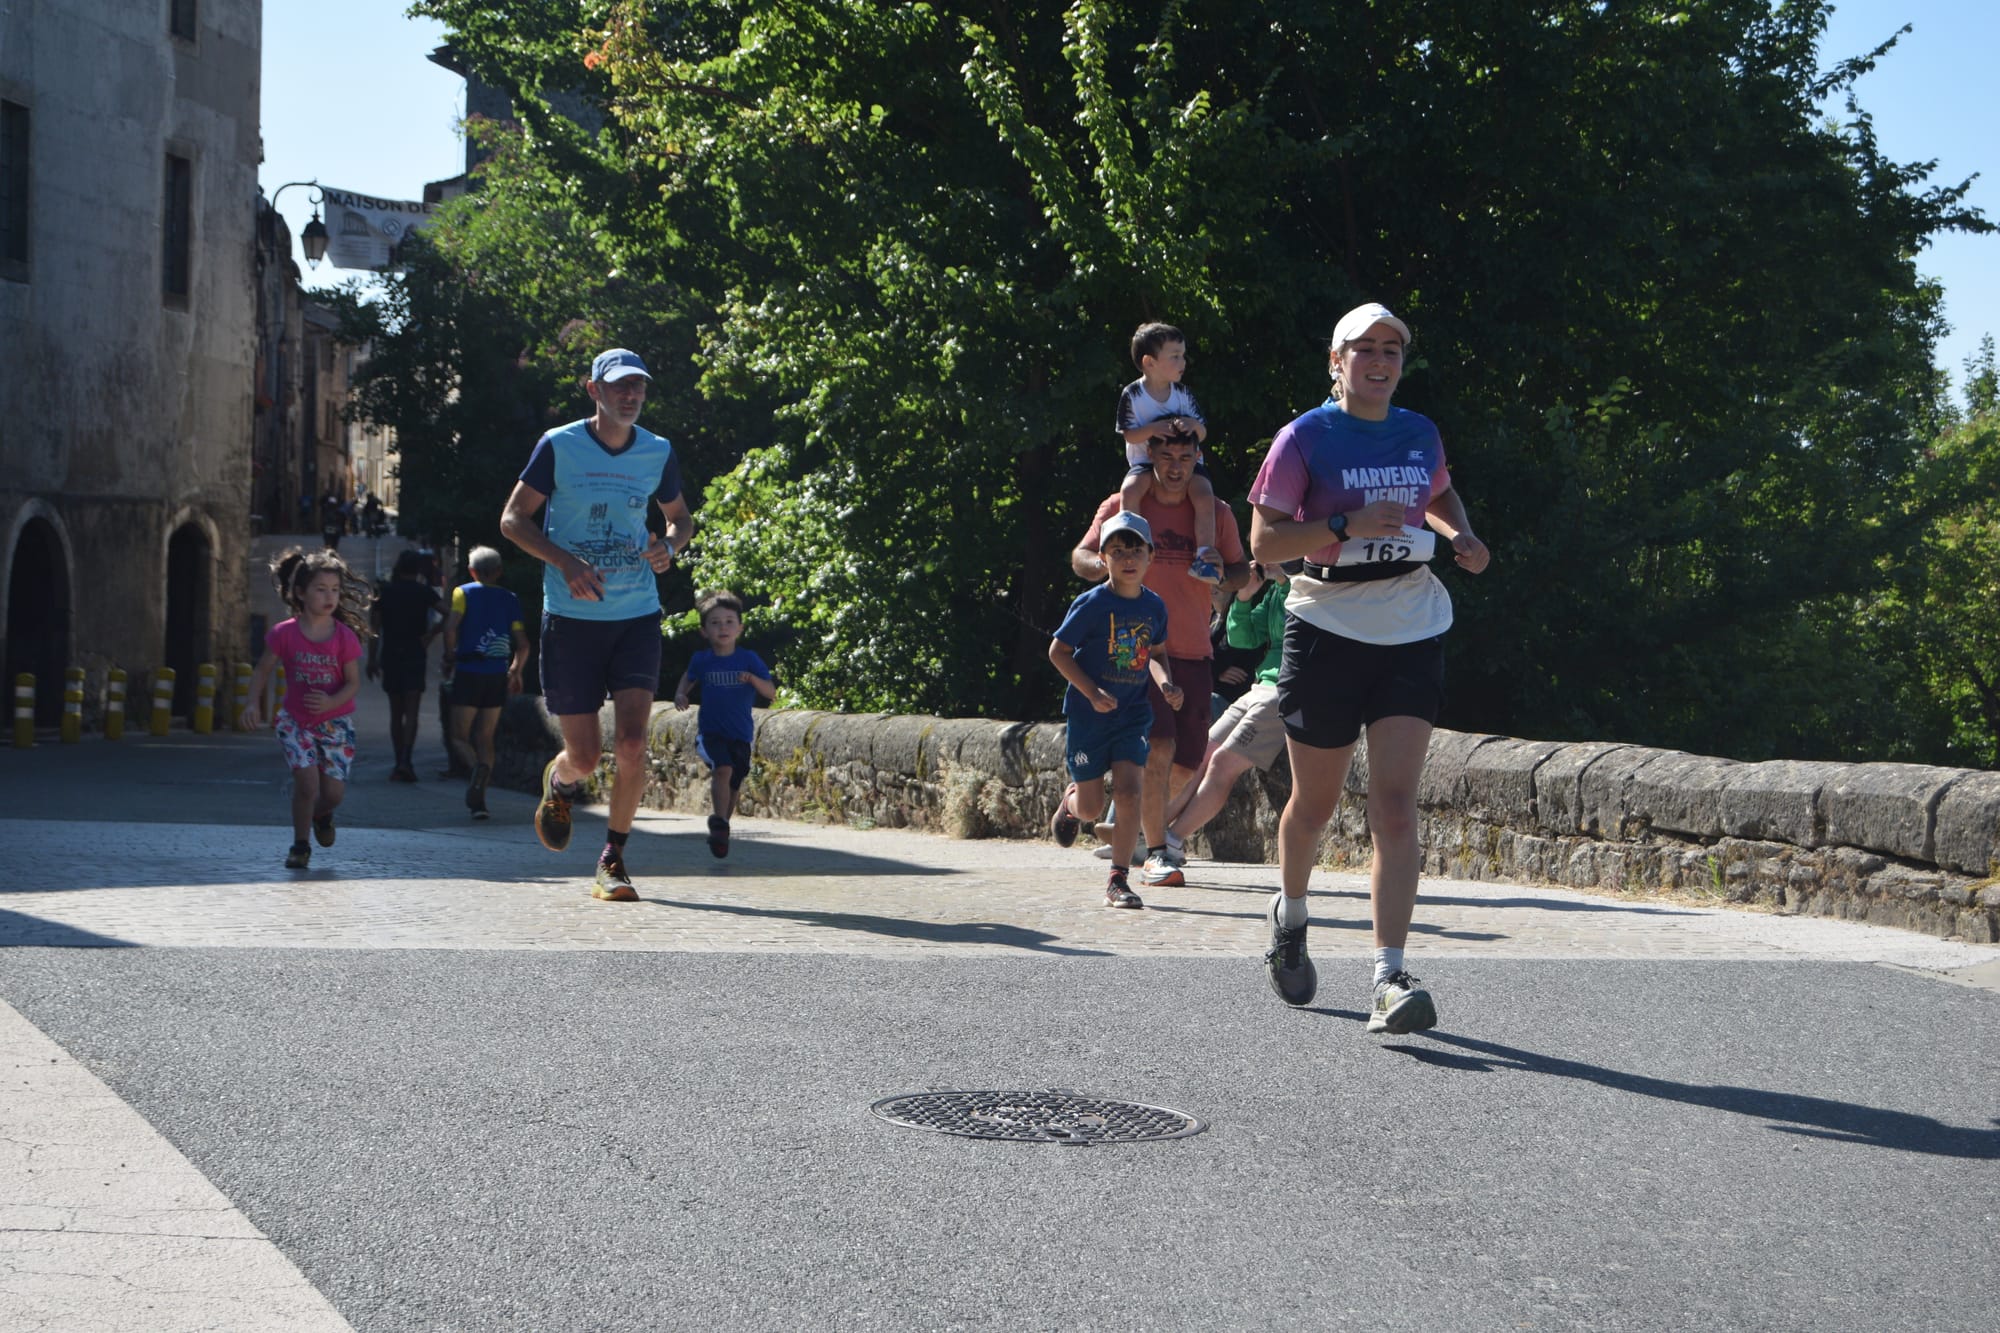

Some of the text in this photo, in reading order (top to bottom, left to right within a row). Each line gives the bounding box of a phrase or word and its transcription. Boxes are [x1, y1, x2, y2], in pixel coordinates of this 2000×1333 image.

[327, 190, 402, 213] MAISON
[1341, 466, 1430, 490] MARVEJOLS
[1364, 486, 1419, 508] MENDE
[1363, 541, 1411, 562] 162
